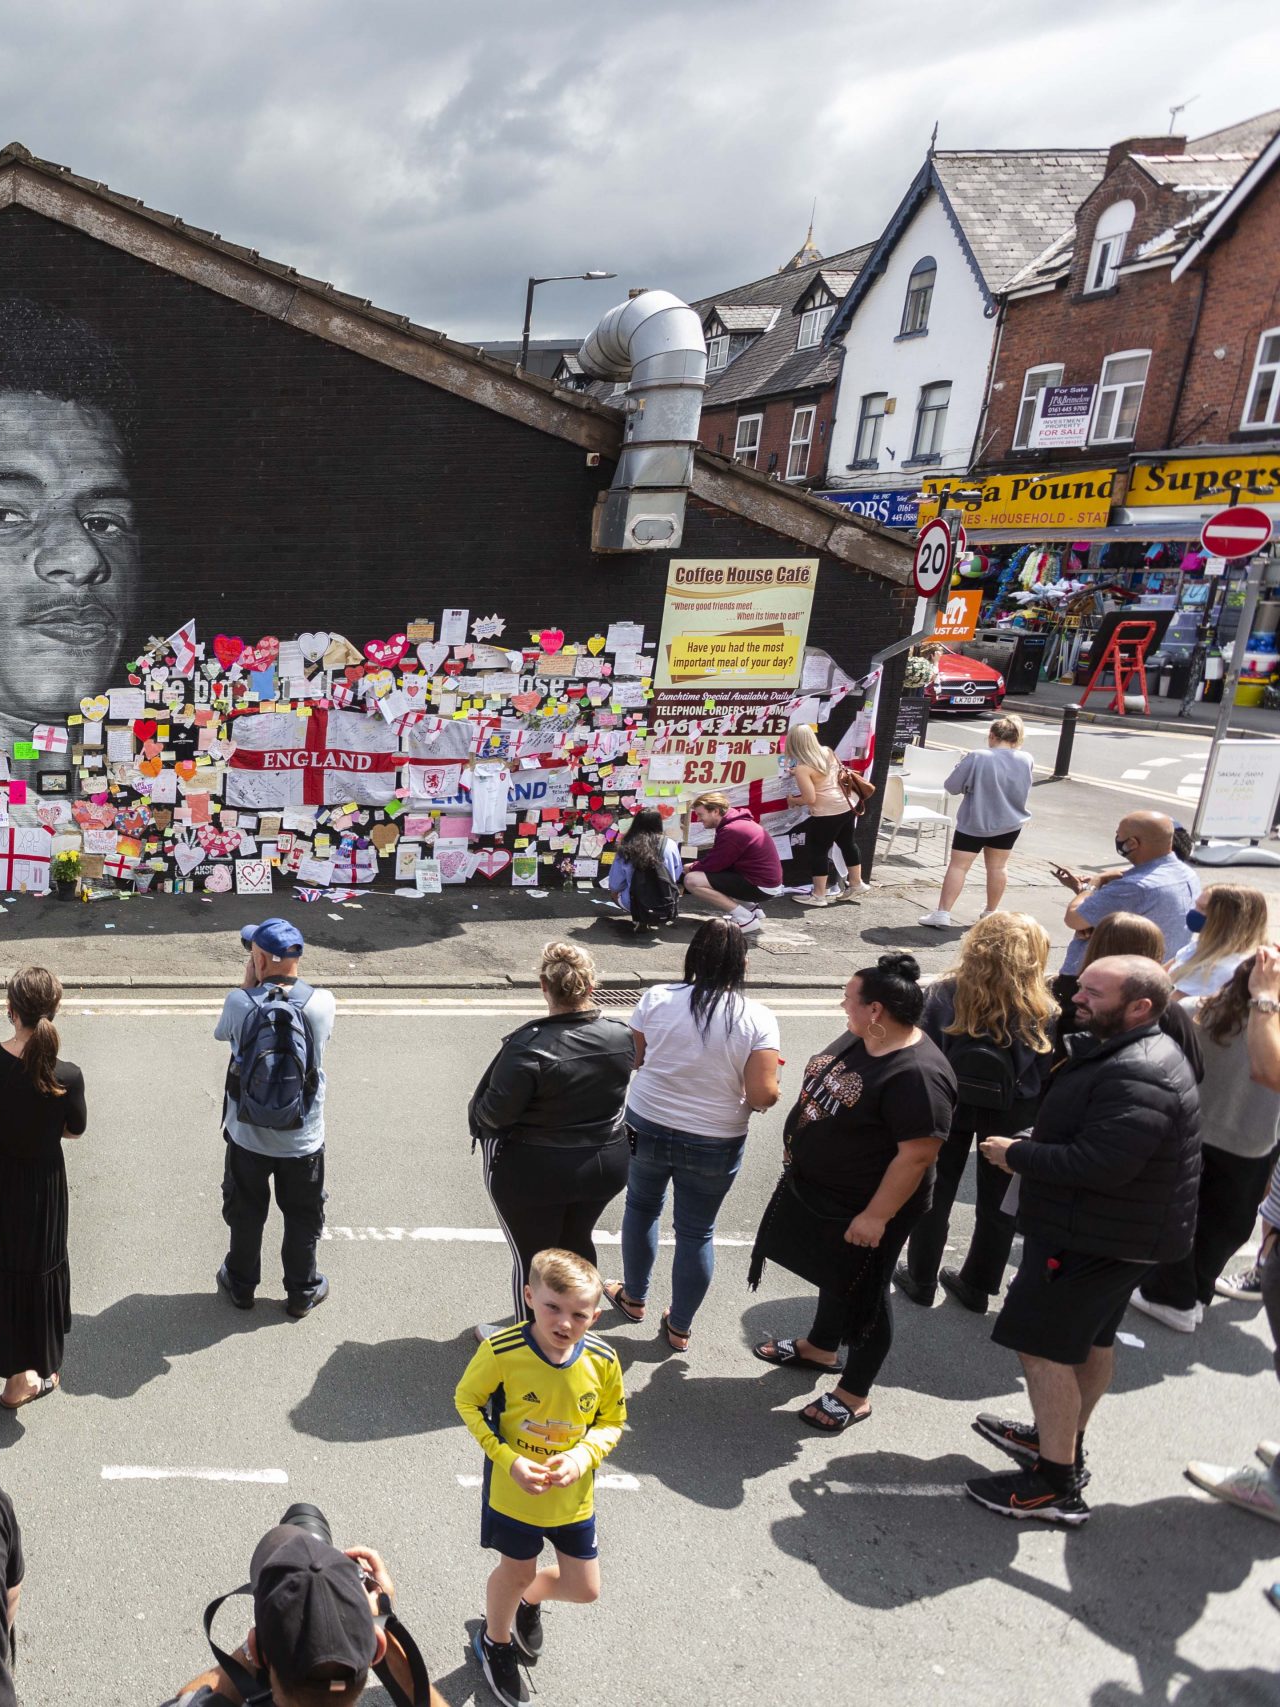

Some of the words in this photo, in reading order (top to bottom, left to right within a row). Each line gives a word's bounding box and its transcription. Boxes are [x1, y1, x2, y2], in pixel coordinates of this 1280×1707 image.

[990, 513, 1066, 524] HOUSEHOLD
[918, 543, 946, 575] 20
[675, 567, 724, 584] Coffee
[726, 567, 774, 584] House
[776, 566, 812, 584] Café
[696, 602, 712, 611] good
[712, 602, 735, 610] friends
[755, 612, 764, 620] its
[764, 611, 780, 620] time
[780, 612, 787, 620] to
[934, 627, 952, 635] UST
[952, 626, 970, 635] EAT
[687, 642, 708, 653] Have
[710, 645, 726, 656] you
[728, 642, 746, 653] had
[746, 642, 760, 652] the
[762, 642, 784, 652] most
[673, 656, 715, 669] important
[717, 656, 738, 667] meal
[740, 656, 750, 667] of
[751, 658, 771, 670] your
[772, 656, 794, 670] day?
[657, 692, 700, 701] Lunchtime
[702, 692, 727, 702] Special
[731, 691, 768, 701] Available
[656, 706, 707, 716] TELEPHONE
[709, 706, 743, 715] ORDERS
[262, 751, 372, 770] ENGLAND
[684, 761, 747, 784] £3.70
